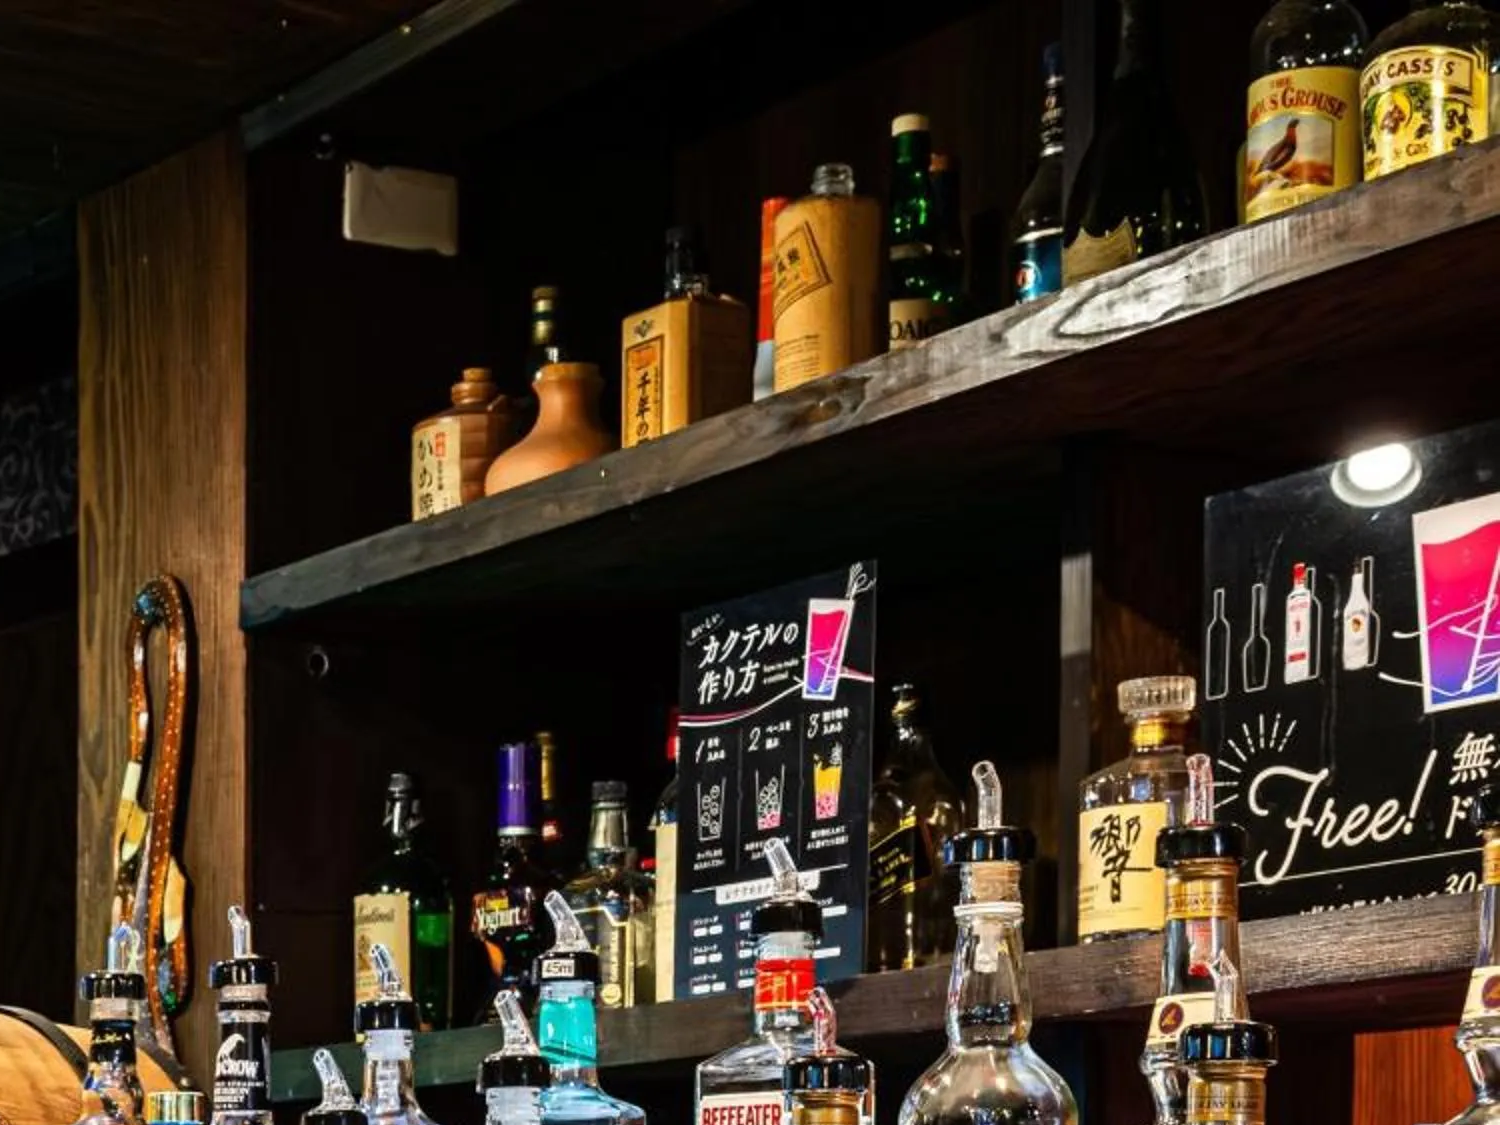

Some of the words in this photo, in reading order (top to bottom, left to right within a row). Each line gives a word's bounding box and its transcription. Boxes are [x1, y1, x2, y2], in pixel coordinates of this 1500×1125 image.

[1281, 86, 1347, 120] GROUSE
[635, 371, 650, 444] 千年の
[698, 622, 800, 669] カクテルの
[698, 659, 760, 705] 作り方
[748, 727, 762, 751] 2
[1248, 750, 1439, 885] Free!
[1089, 813, 1153, 903] 響
